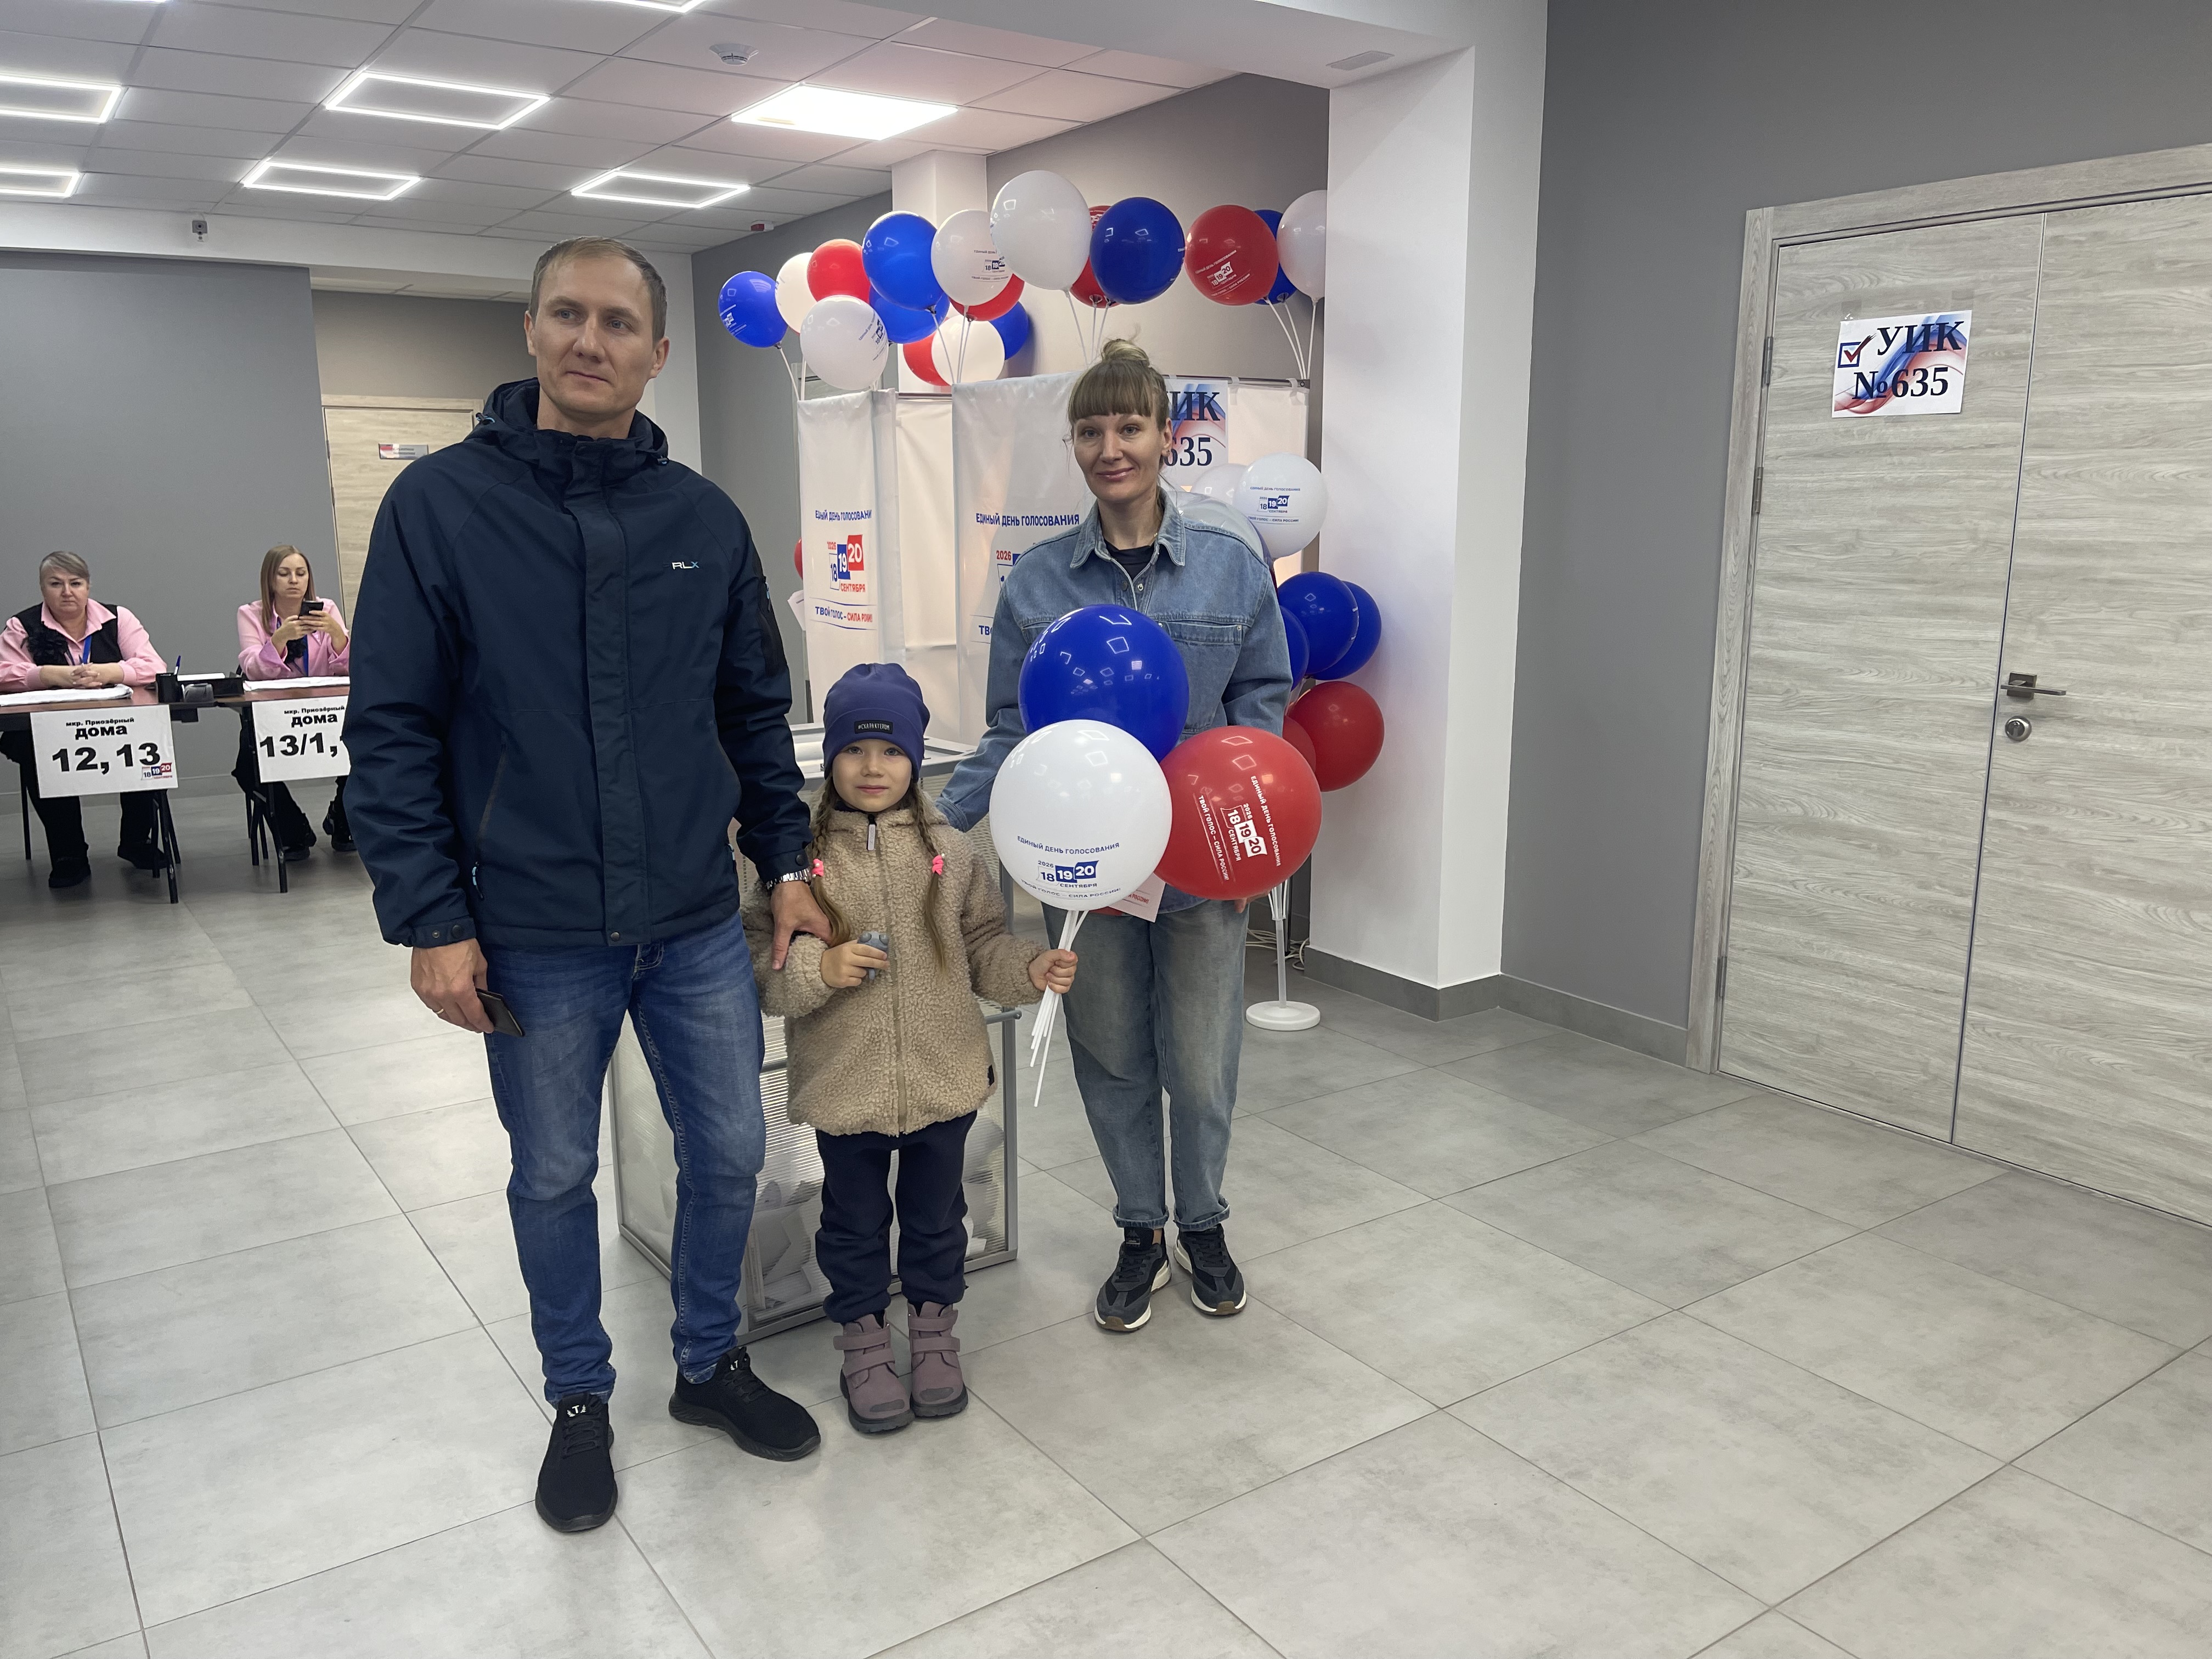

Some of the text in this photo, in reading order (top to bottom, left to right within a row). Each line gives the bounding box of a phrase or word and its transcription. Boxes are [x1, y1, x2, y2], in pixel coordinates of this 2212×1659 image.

[1222, 266, 1231, 274] 20
[1877, 321, 1965, 356] УИК
[1166, 391, 1220, 421] ИК
[829, 511, 840, 522] ДЕНЬ
[976, 512, 1080, 527] ЕДИНЫЙ ДЕНЬ ГОЛОСОВАНИЯ
[830, 543, 862, 582] 18 19 20
[996, 550, 1012, 561] 2026
[672, 561, 699, 569] RLX
[840, 583, 866, 592] СЕНТЯБРЯ
[815, 606, 831, 617] ТВОЙ
[831, 609, 843, 620] ГОЛОС
[847, 612, 860, 621] СИЛА
[978, 625, 992, 635] ТВ
[291, 713, 338, 728] дома
[75, 725, 128, 740] дома
[259, 732, 338, 758] 13/1,
[52, 743, 161, 775] 12, 13
[1243, 803, 1253, 820] 2026
[1198, 795, 1210, 813] ТВОЙ
[1205, 812, 1216, 835] ГОЛОС
[1214, 840, 1223, 858] СИЛА
[1250, 775, 1281, 867] ЕДИНЫЙ ДЕНЬ ГОЛОСОВАНИЯ
[1227, 809, 1262, 854] 18 19 20
[1017, 836, 1120, 854] ЕДИНЫЙ ДЕНЬ ГОЛОСОВАНИЯ
[1228, 829, 1242, 861] СЕНТЯБРЯ
[1037, 860, 1054, 868] 2026
[1040, 865, 1095, 882] 18 19 20
